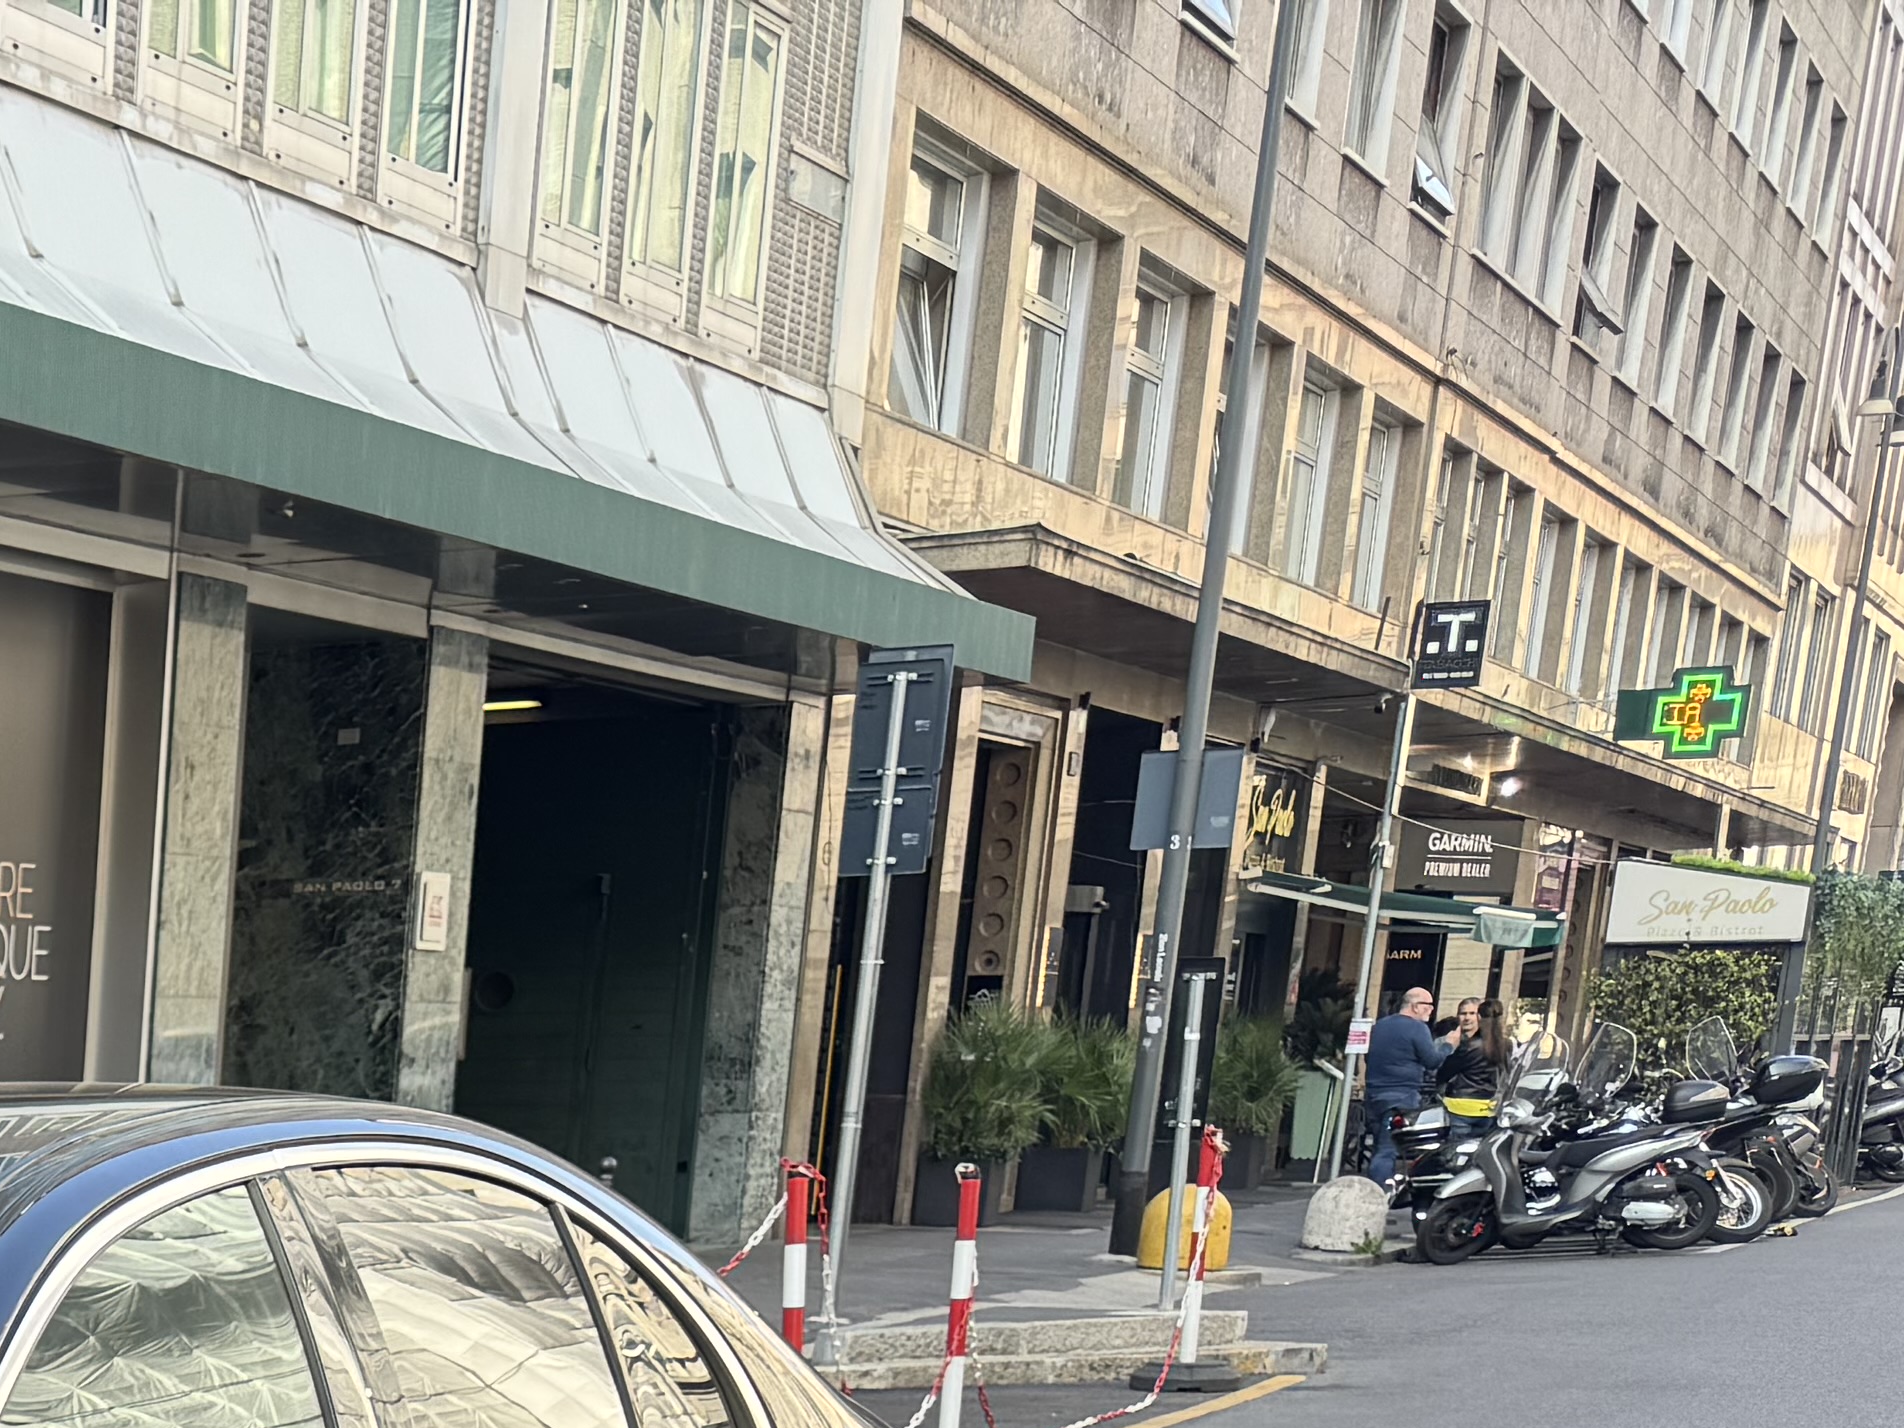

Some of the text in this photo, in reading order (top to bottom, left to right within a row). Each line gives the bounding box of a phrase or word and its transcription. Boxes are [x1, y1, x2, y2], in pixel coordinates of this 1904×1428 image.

[1428, 832, 1493, 853] GARMIN
[331, 879, 386, 893] PAOLO
[1637, 885, 1779, 926] San Paolo
[1387, 949, 1422, 960] ARM
